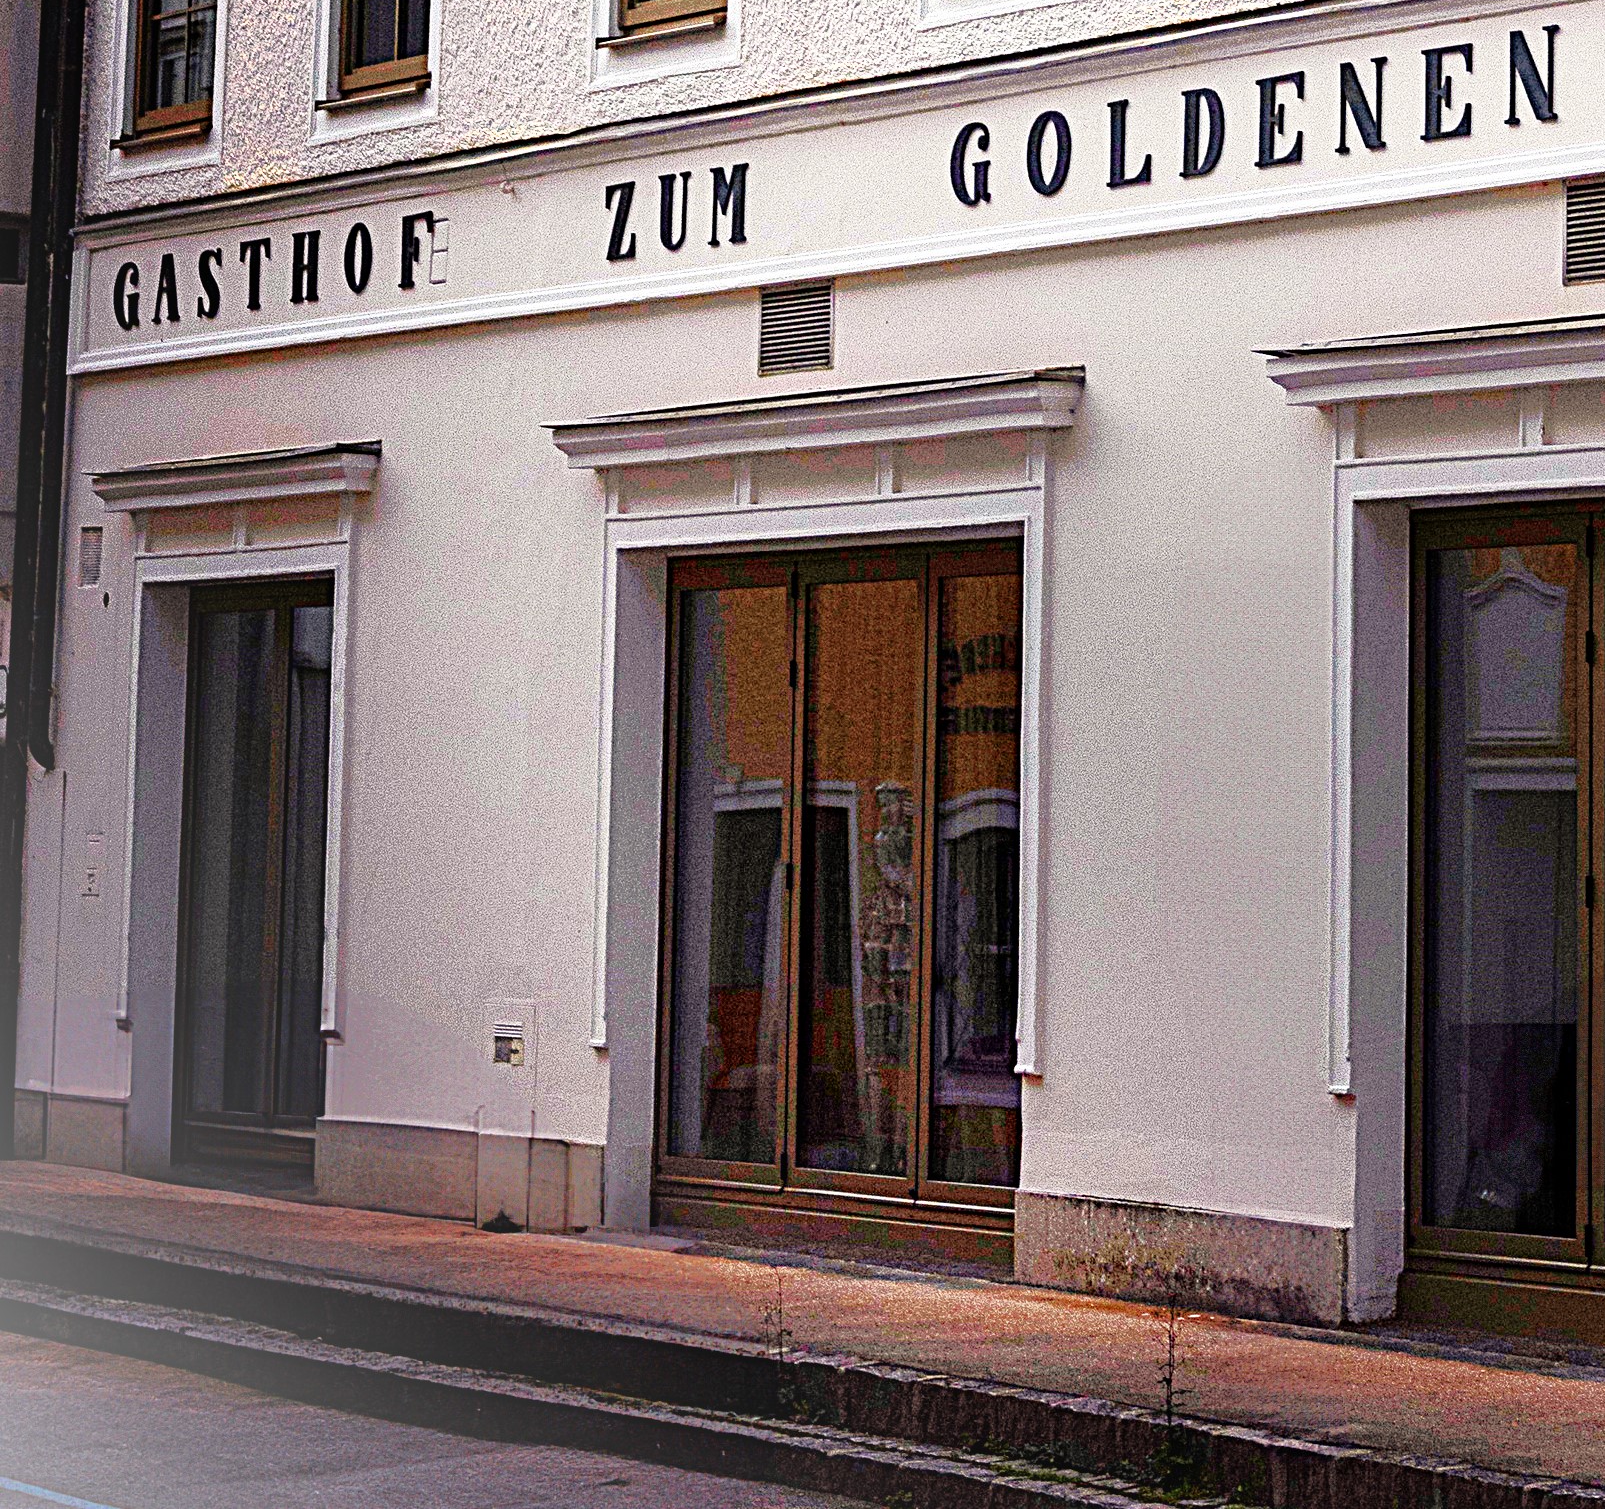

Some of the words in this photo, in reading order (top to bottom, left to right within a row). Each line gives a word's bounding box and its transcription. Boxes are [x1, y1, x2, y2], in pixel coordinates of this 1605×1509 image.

[113, 210, 434, 332] GASTHOF
[605, 163, 749, 263] ZUM
[950, 24, 1560, 207] GOLDENEN
